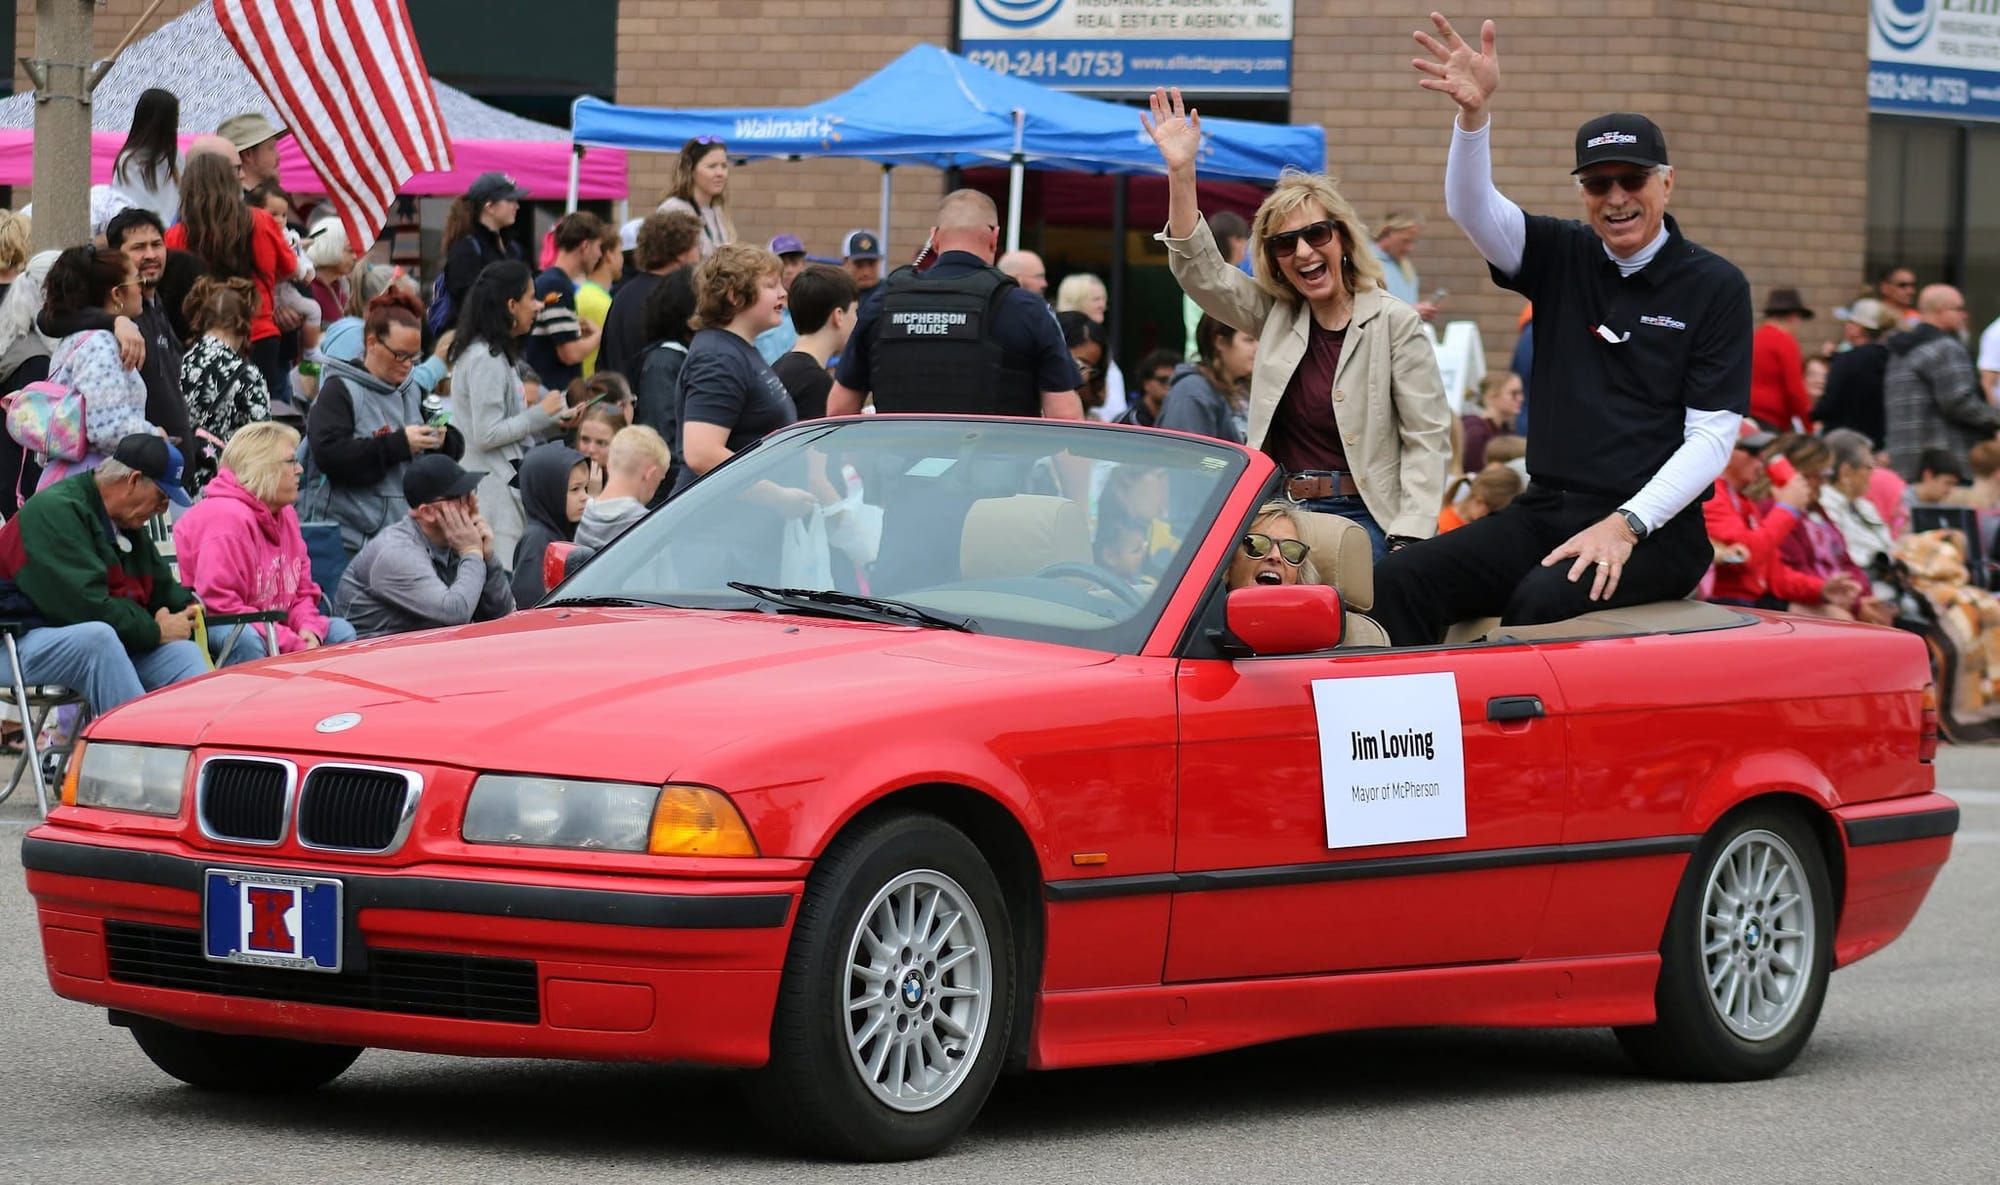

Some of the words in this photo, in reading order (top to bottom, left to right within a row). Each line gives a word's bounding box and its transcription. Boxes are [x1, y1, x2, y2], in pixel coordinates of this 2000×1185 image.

[1076, 14, 1115, 28] REAL
[1120, 14, 1177, 28] ESTATE
[892, 312, 967, 325] MCPHERSON
[906, 324, 949, 335] POLICE
[1351, 731, 1379, 760] Jim
[1380, 727, 1435, 760] Loving
[1351, 784, 1380, 803] Mayor
[1381, 782, 1390, 800] of
[1392, 781, 1440, 799] McPherson
[247, 886, 296, 955] K
